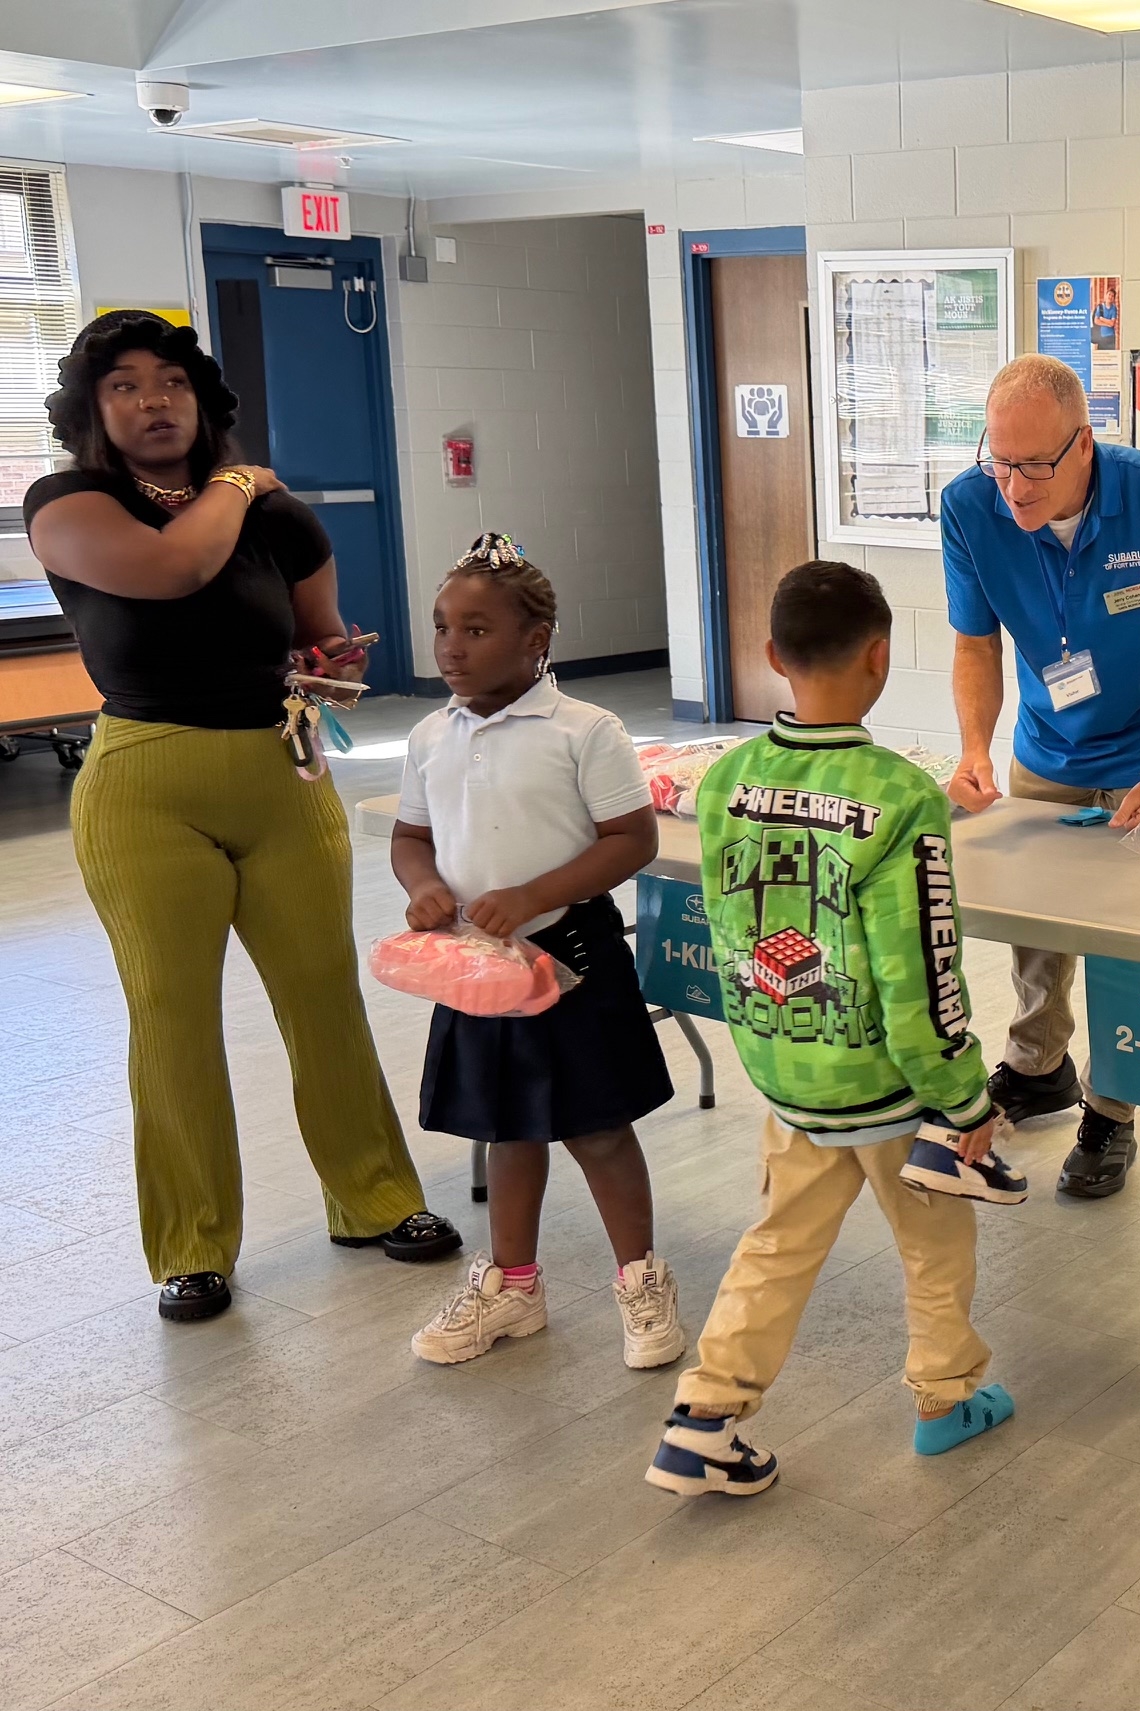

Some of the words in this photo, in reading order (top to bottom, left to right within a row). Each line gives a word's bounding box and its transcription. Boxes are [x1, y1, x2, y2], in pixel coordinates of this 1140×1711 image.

[302, 194, 339, 233] EXIT
[957, 295, 983, 303] JISTIS
[681, 914, 710, 925] SUBA
[756, 962, 783, 991] TNT
[790, 969, 818, 992] TNT
